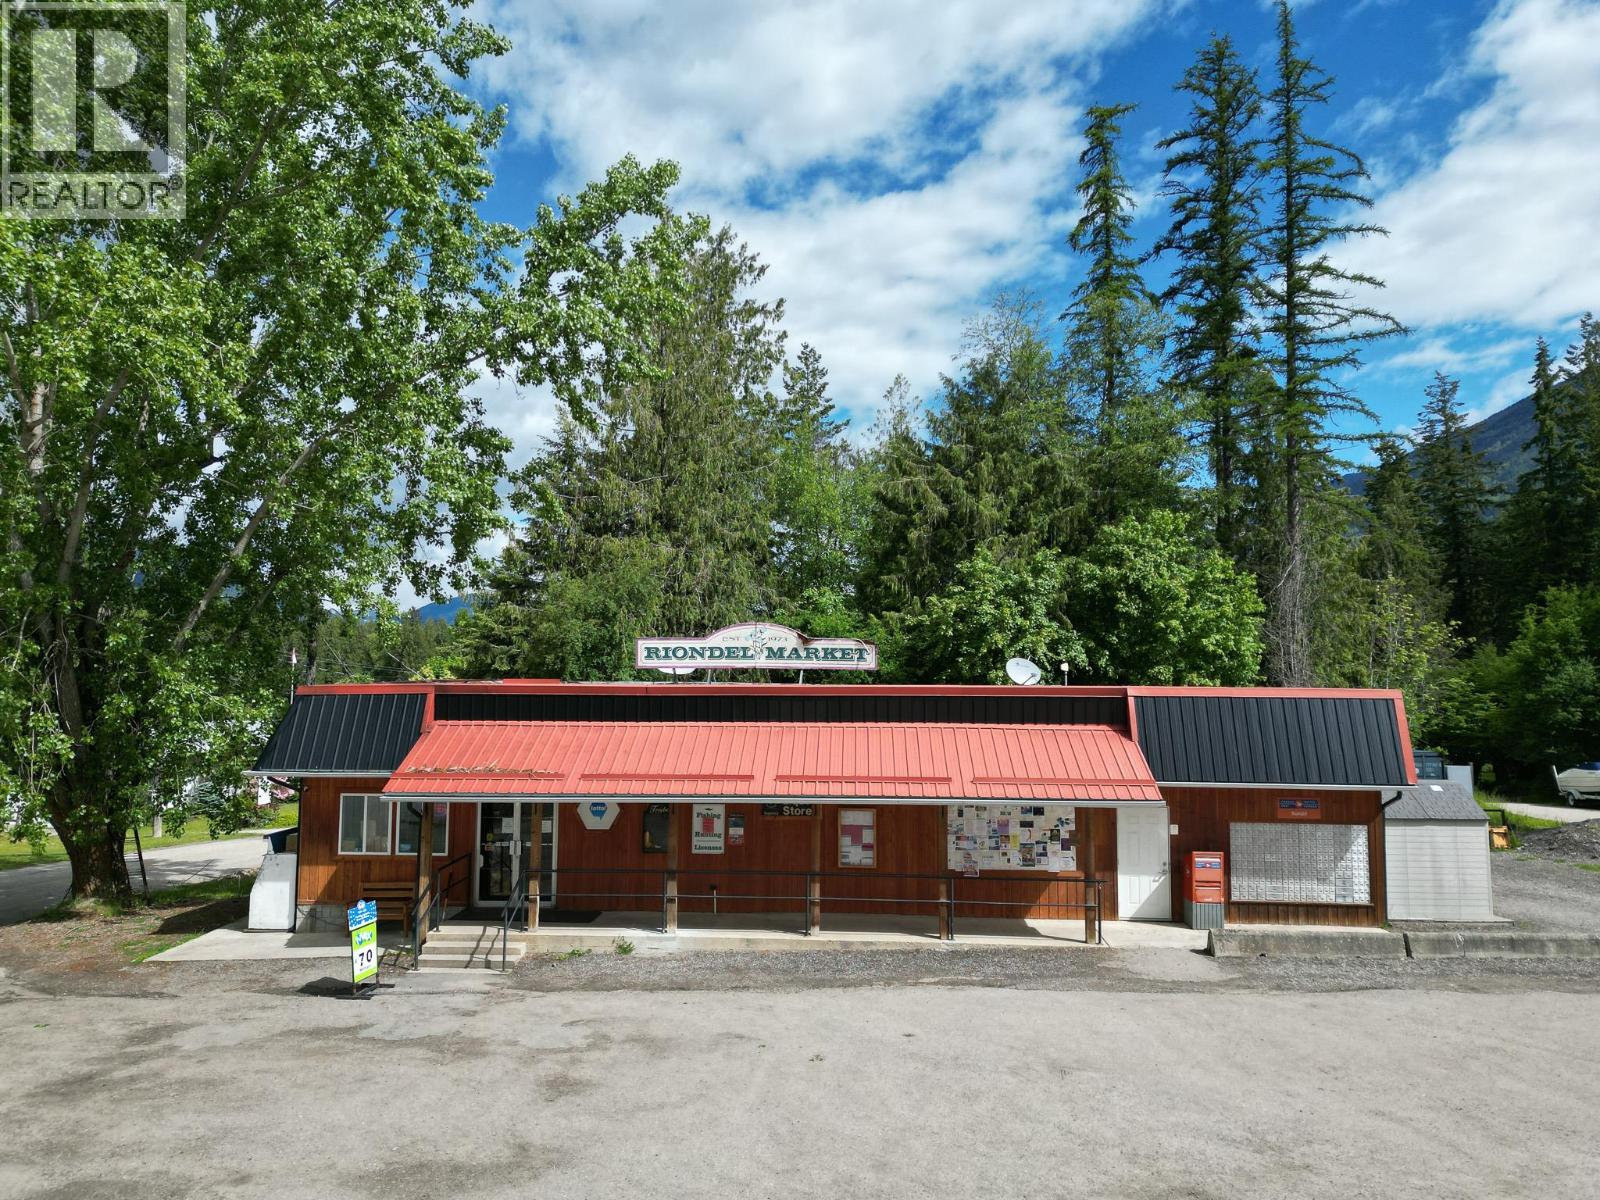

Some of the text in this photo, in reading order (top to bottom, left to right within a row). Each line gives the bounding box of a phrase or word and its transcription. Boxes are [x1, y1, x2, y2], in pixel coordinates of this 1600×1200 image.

[644, 646, 870, 662] RIONDEL MARKET
[696, 812, 722, 820] Fishing
[783, 806, 813, 816] Store
[694, 831, 722, 839] Hunting
[358, 948, 373, 966] 70
